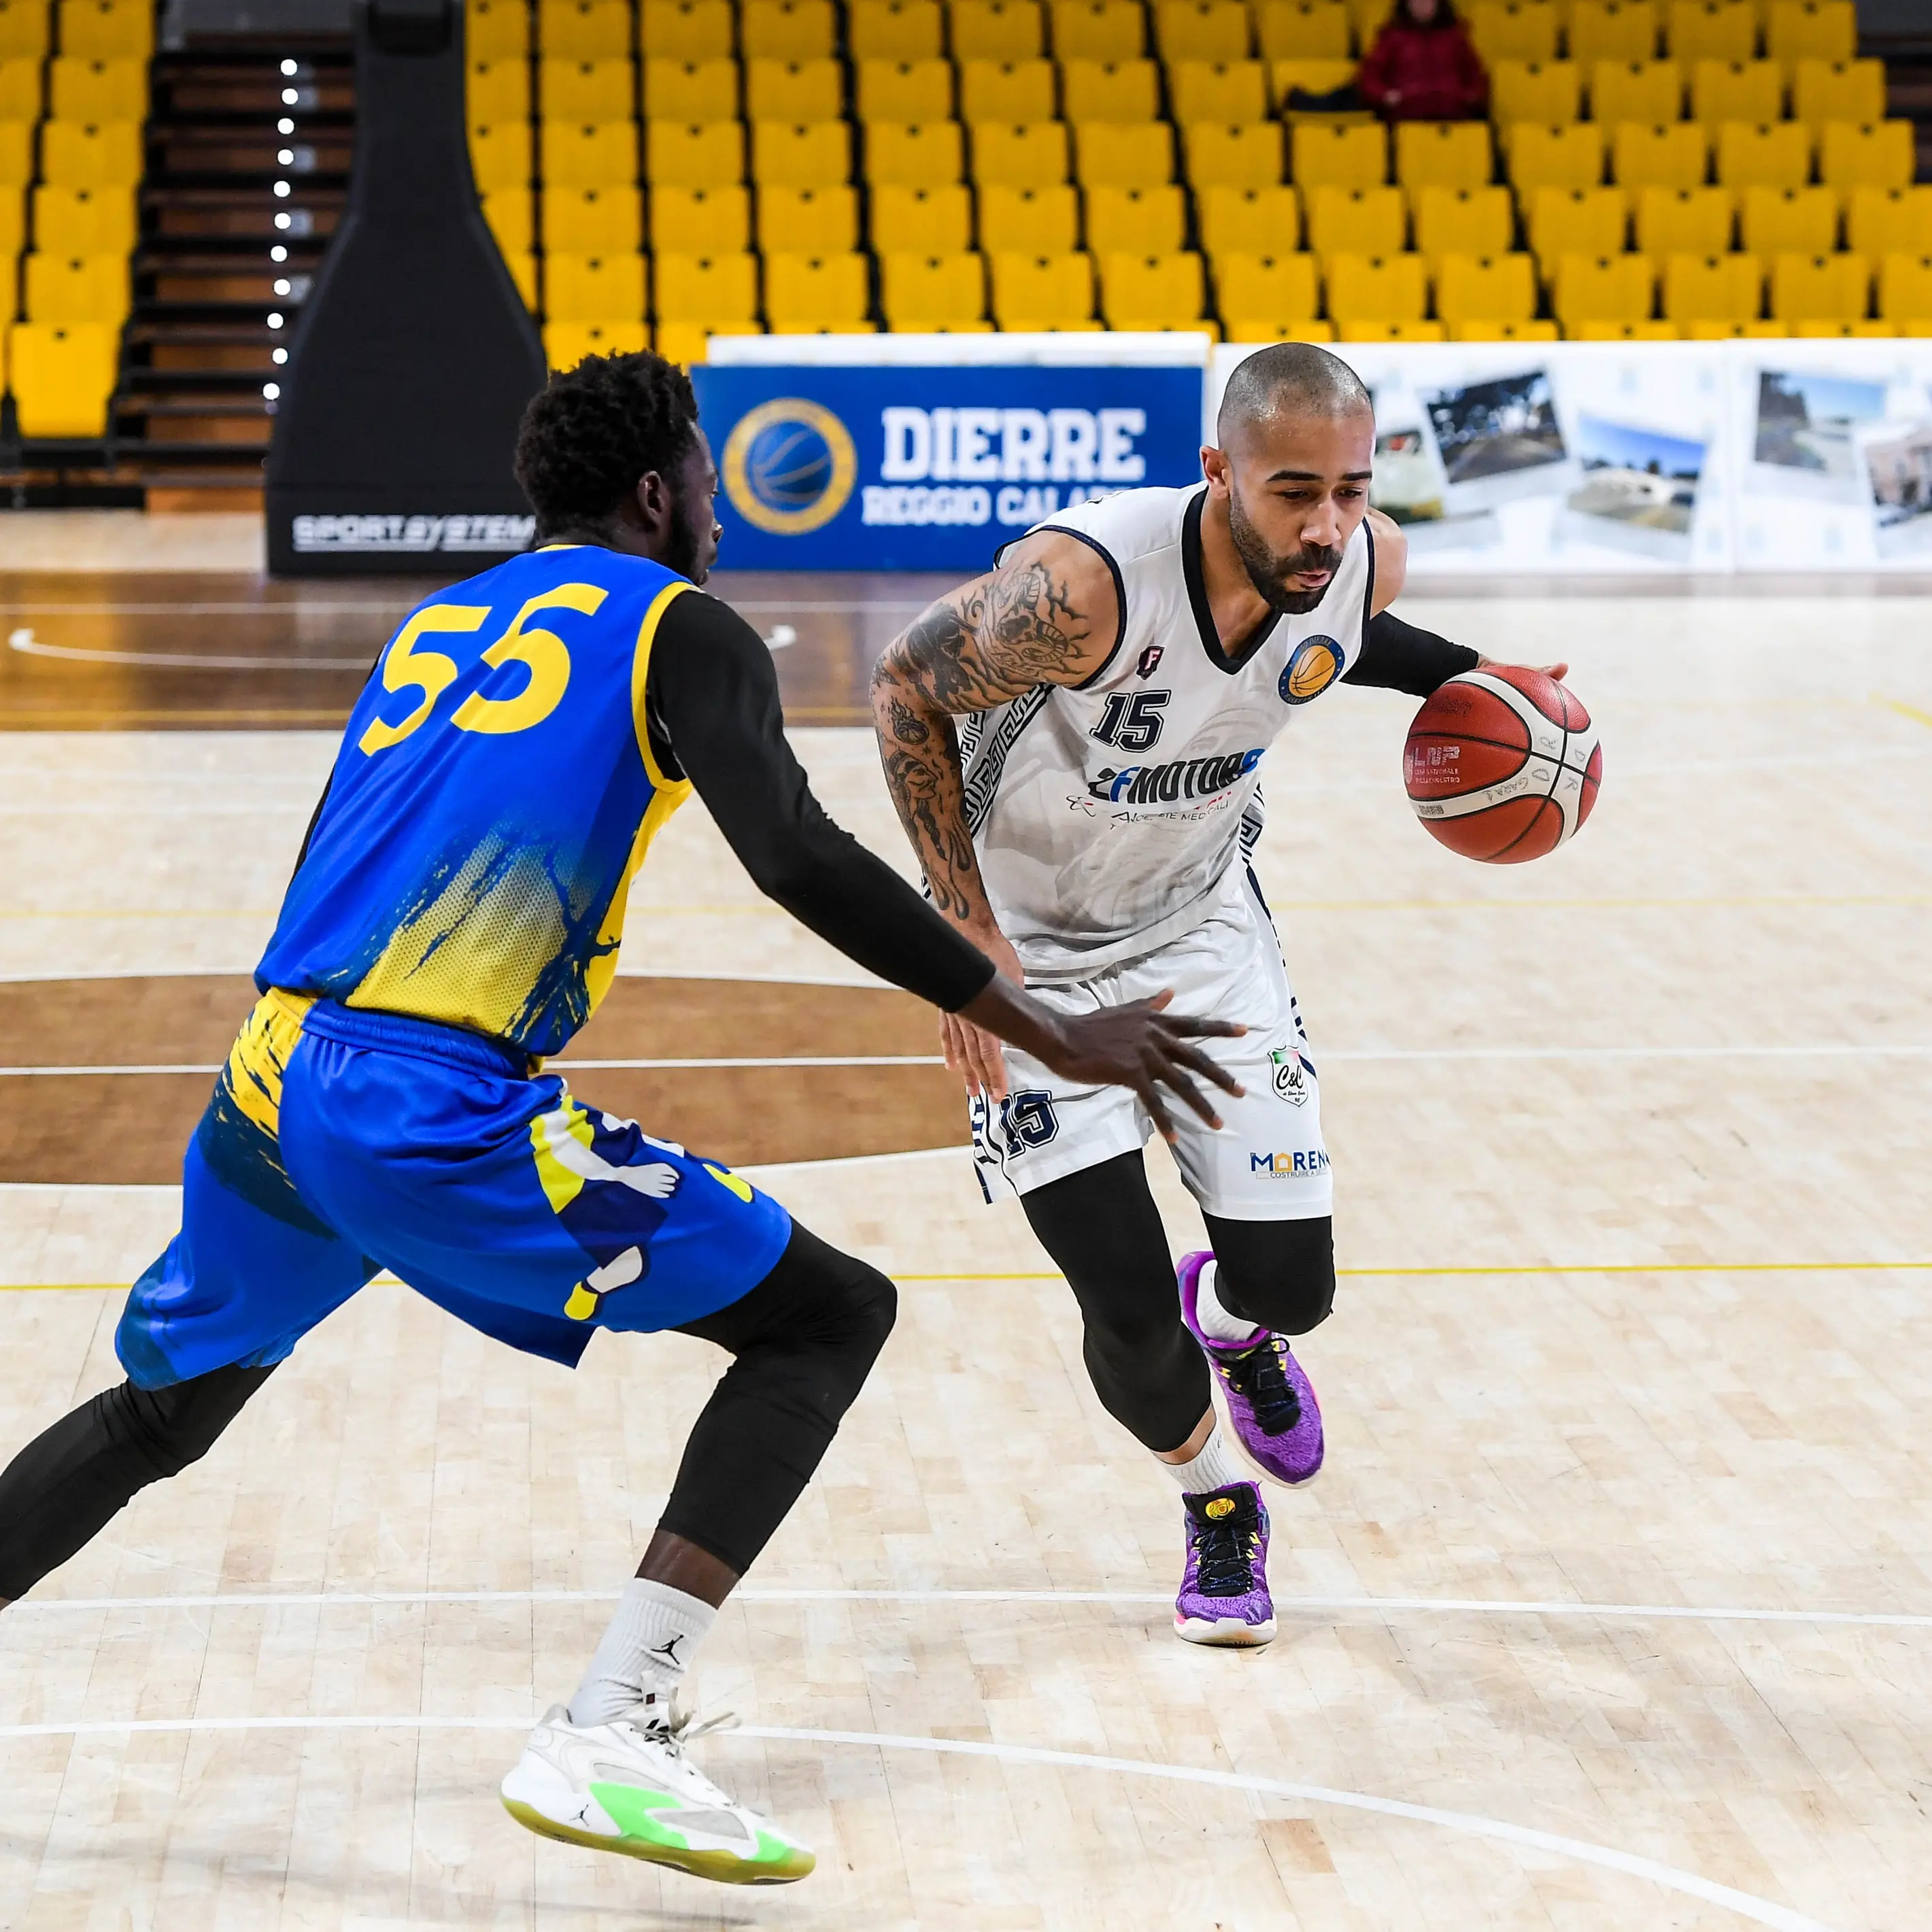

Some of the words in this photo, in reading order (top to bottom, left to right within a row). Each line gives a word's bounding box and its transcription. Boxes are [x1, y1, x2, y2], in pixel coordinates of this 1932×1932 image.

[881, 407, 1147, 481] DIERRE
[862, 485, 992, 527] REGGIO
[996, 485, 1132, 526] CALA
[358, 583, 609, 757] 55
[1089, 689, 1172, 753] 15
[1181, 800, 1228, 821] MEDCALI
[999, 1089, 1060, 1161] 15
[1250, 1149, 1331, 1172] MOREN
